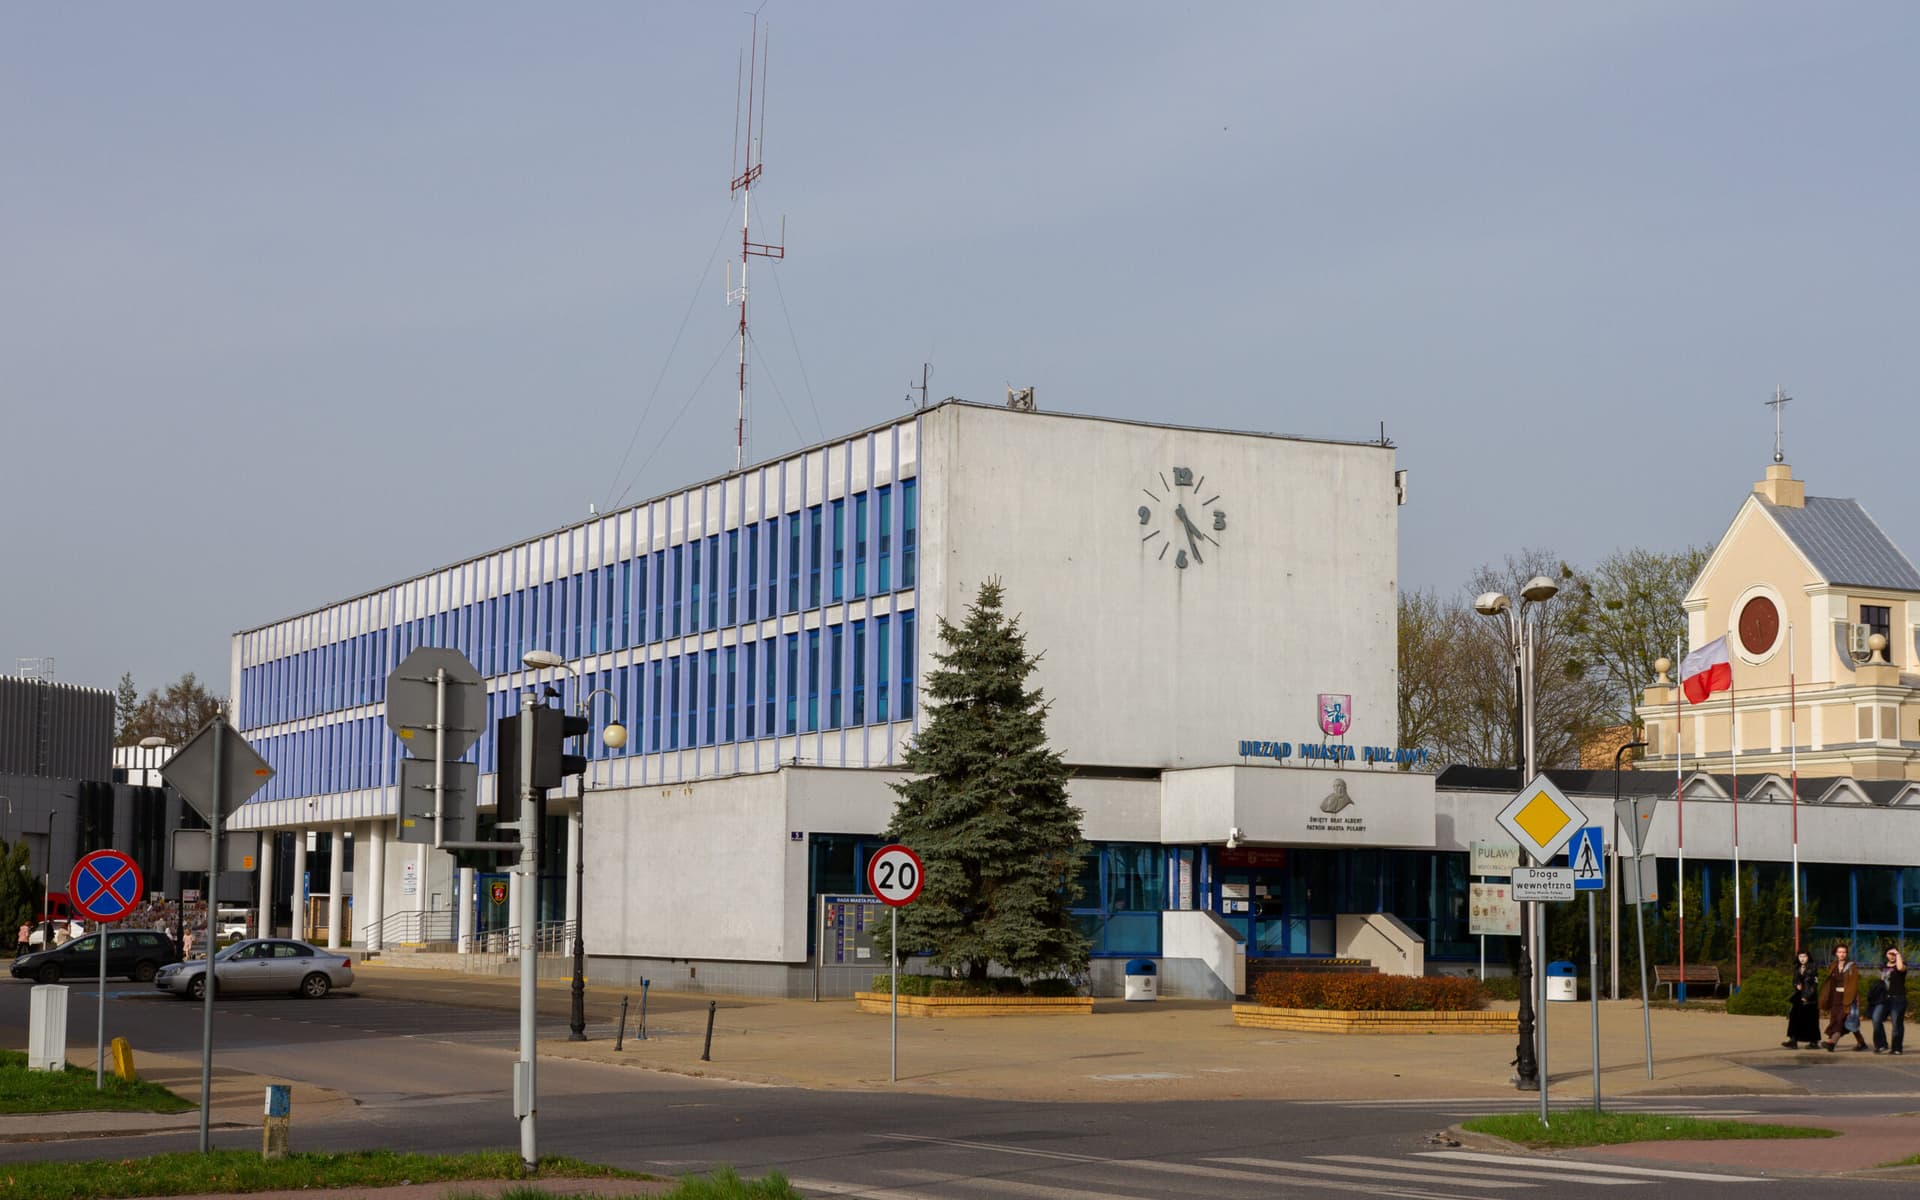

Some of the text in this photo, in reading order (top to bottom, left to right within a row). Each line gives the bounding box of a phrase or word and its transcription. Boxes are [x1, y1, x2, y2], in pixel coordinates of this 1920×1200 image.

[1173, 467, 1193, 486] 12
[1138, 506, 1151, 525] 9
[1213, 511, 1226, 531] 3
[1175, 550, 1188, 569] 6
[1239, 740, 1428, 764] URZĄD MIASTA PUŁAWY
[879, 861, 916, 890] 20
[1529, 869, 1559, 880] Droga
